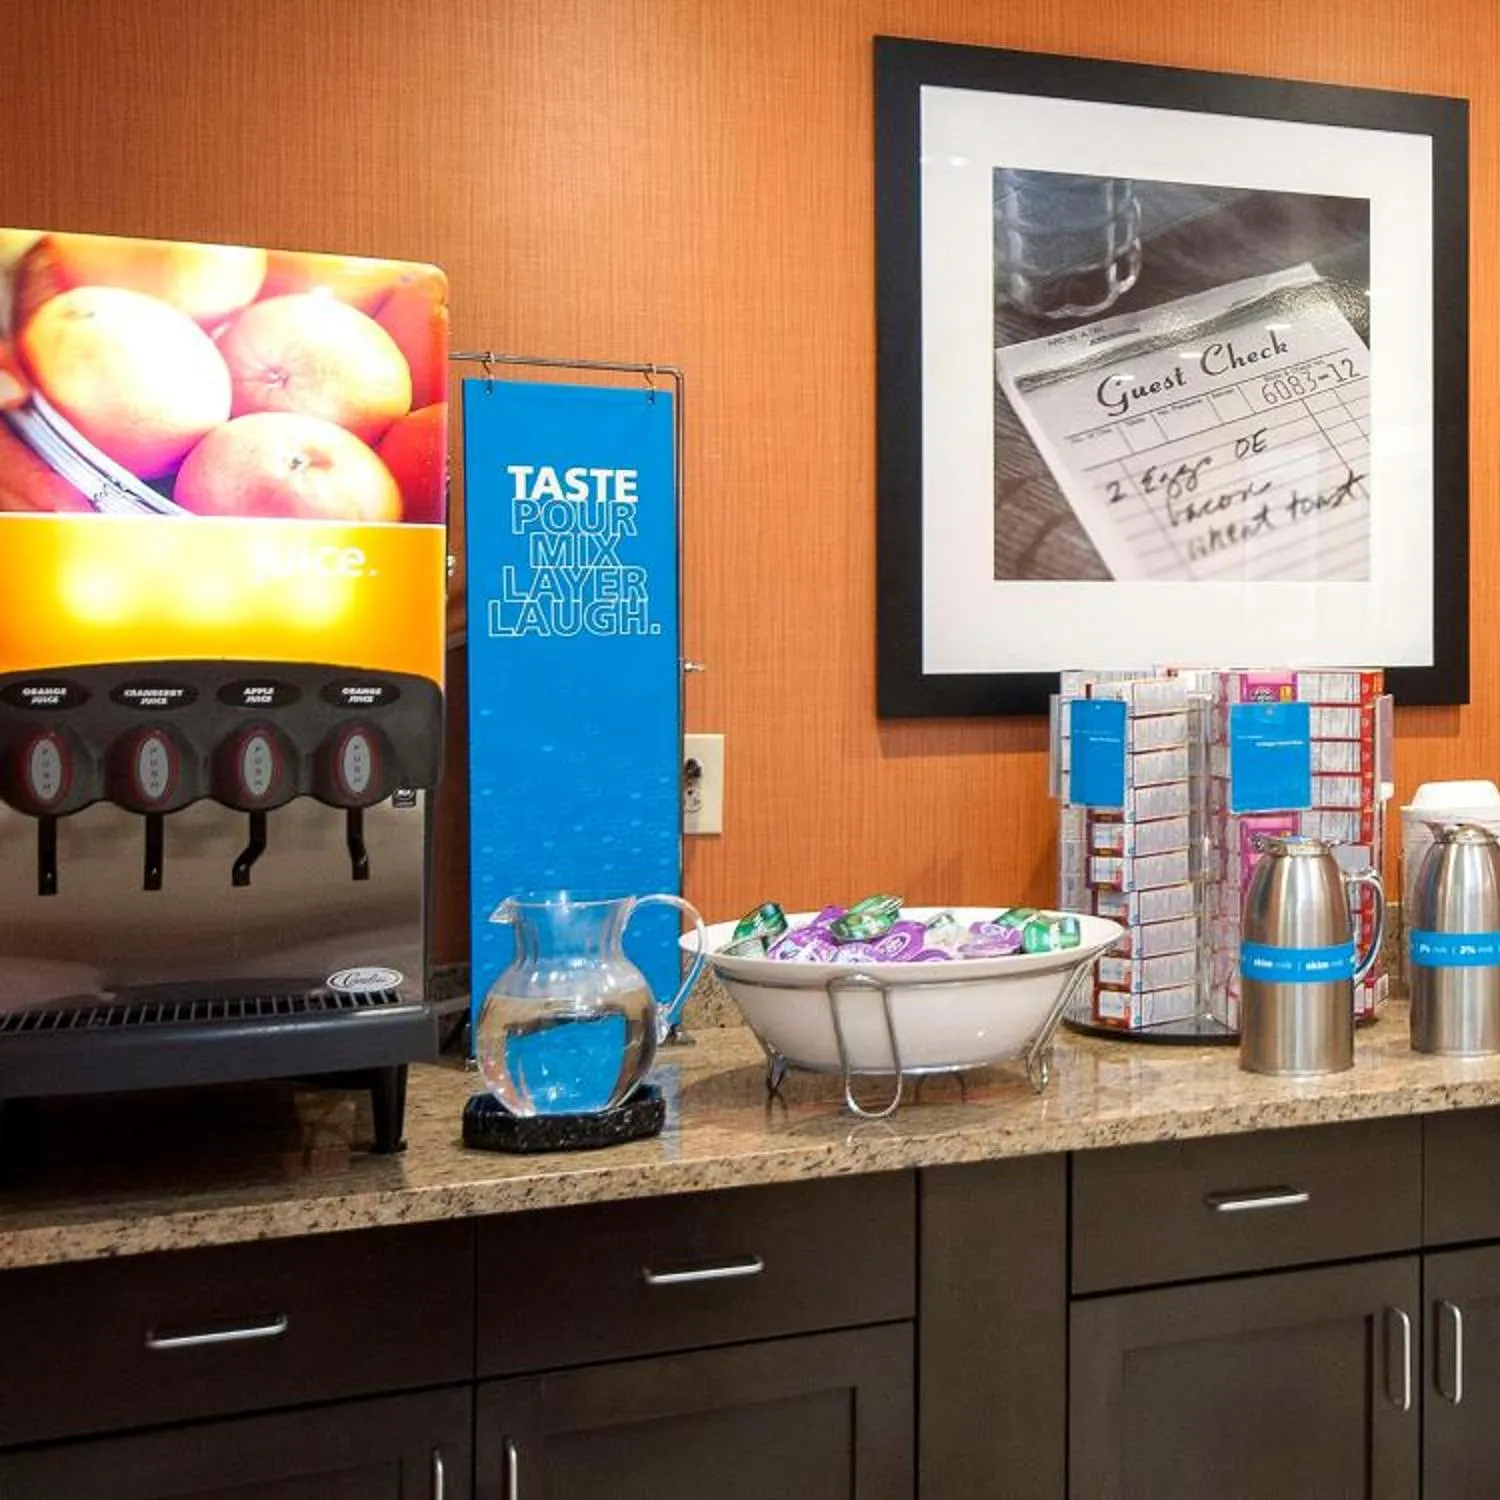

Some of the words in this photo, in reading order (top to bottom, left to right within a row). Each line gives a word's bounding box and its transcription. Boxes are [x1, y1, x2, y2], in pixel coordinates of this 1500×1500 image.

[1096, 366, 1187, 417] Guest
[1200, 330, 1289, 376] Check
[1261, 357, 1361, 405] 6083-12
[507, 465, 639, 503] TASTE
[1106, 480, 1128, 504] 2
[511, 498, 638, 537] POUR
[529, 531, 623, 569] MIX
[503, 565, 649, 603] LAYER
[487, 599, 662, 638] LAUGH.
